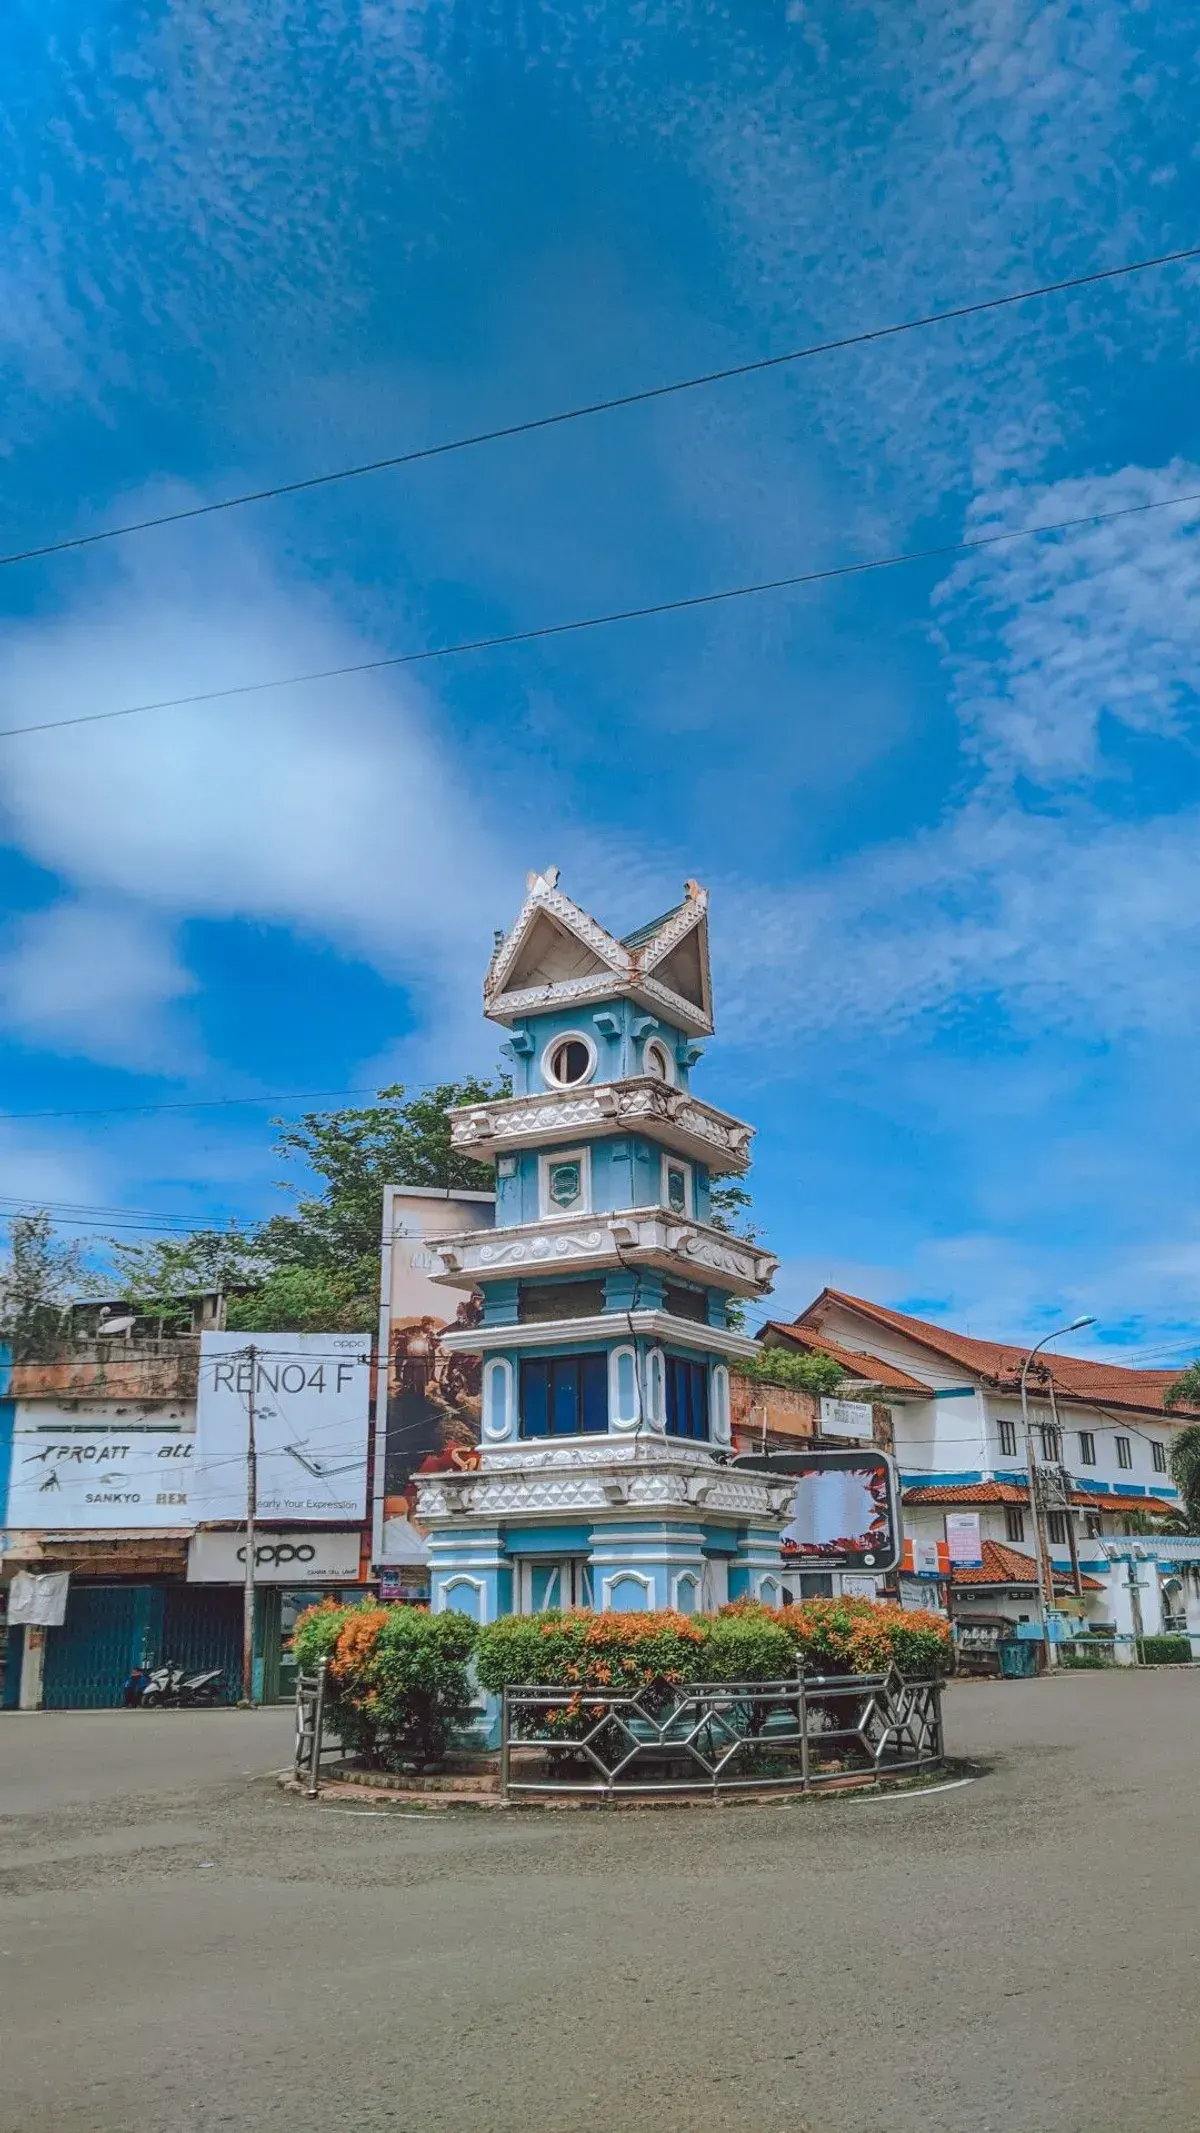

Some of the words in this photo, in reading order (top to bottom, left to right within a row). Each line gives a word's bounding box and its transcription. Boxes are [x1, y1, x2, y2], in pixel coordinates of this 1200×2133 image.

[333, 1340, 365, 1349] oppo
[214, 1363, 327, 1393] RENO4
[337, 1363, 354, 1393] F
[157, 1443, 195, 1458] att
[85, 1493, 141, 1504] SANKYO
[156, 1493, 188, 1505] REX
[284, 1499, 304, 1508] Your
[307, 1499, 357, 1511] Expression
